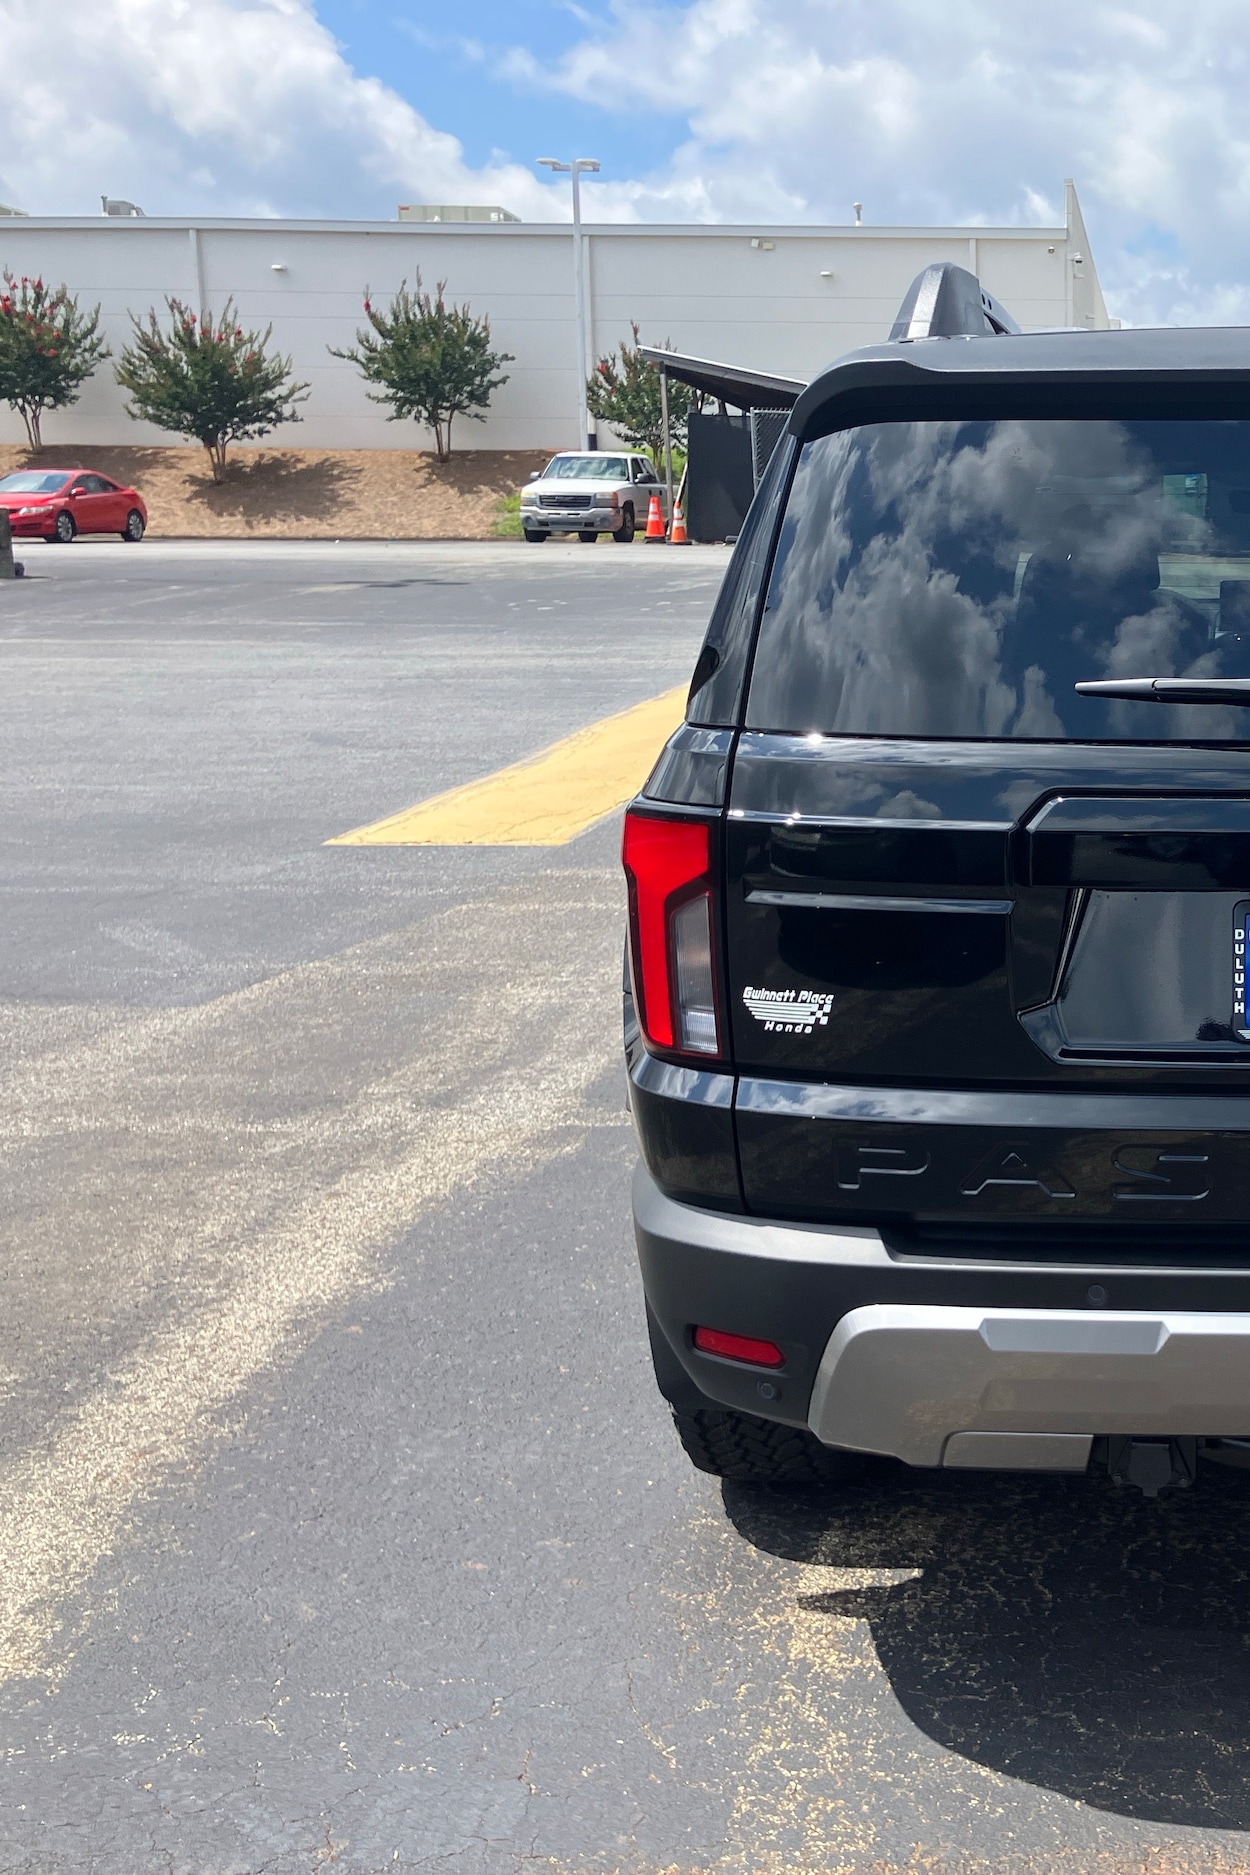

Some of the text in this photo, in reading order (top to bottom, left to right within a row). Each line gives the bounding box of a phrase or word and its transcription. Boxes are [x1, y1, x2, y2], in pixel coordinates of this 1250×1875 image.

[1234, 928, 1244, 1014] DULUTH
[742, 986, 834, 1004] Gwinnett Place
[764, 1021, 813, 1034] Honda
